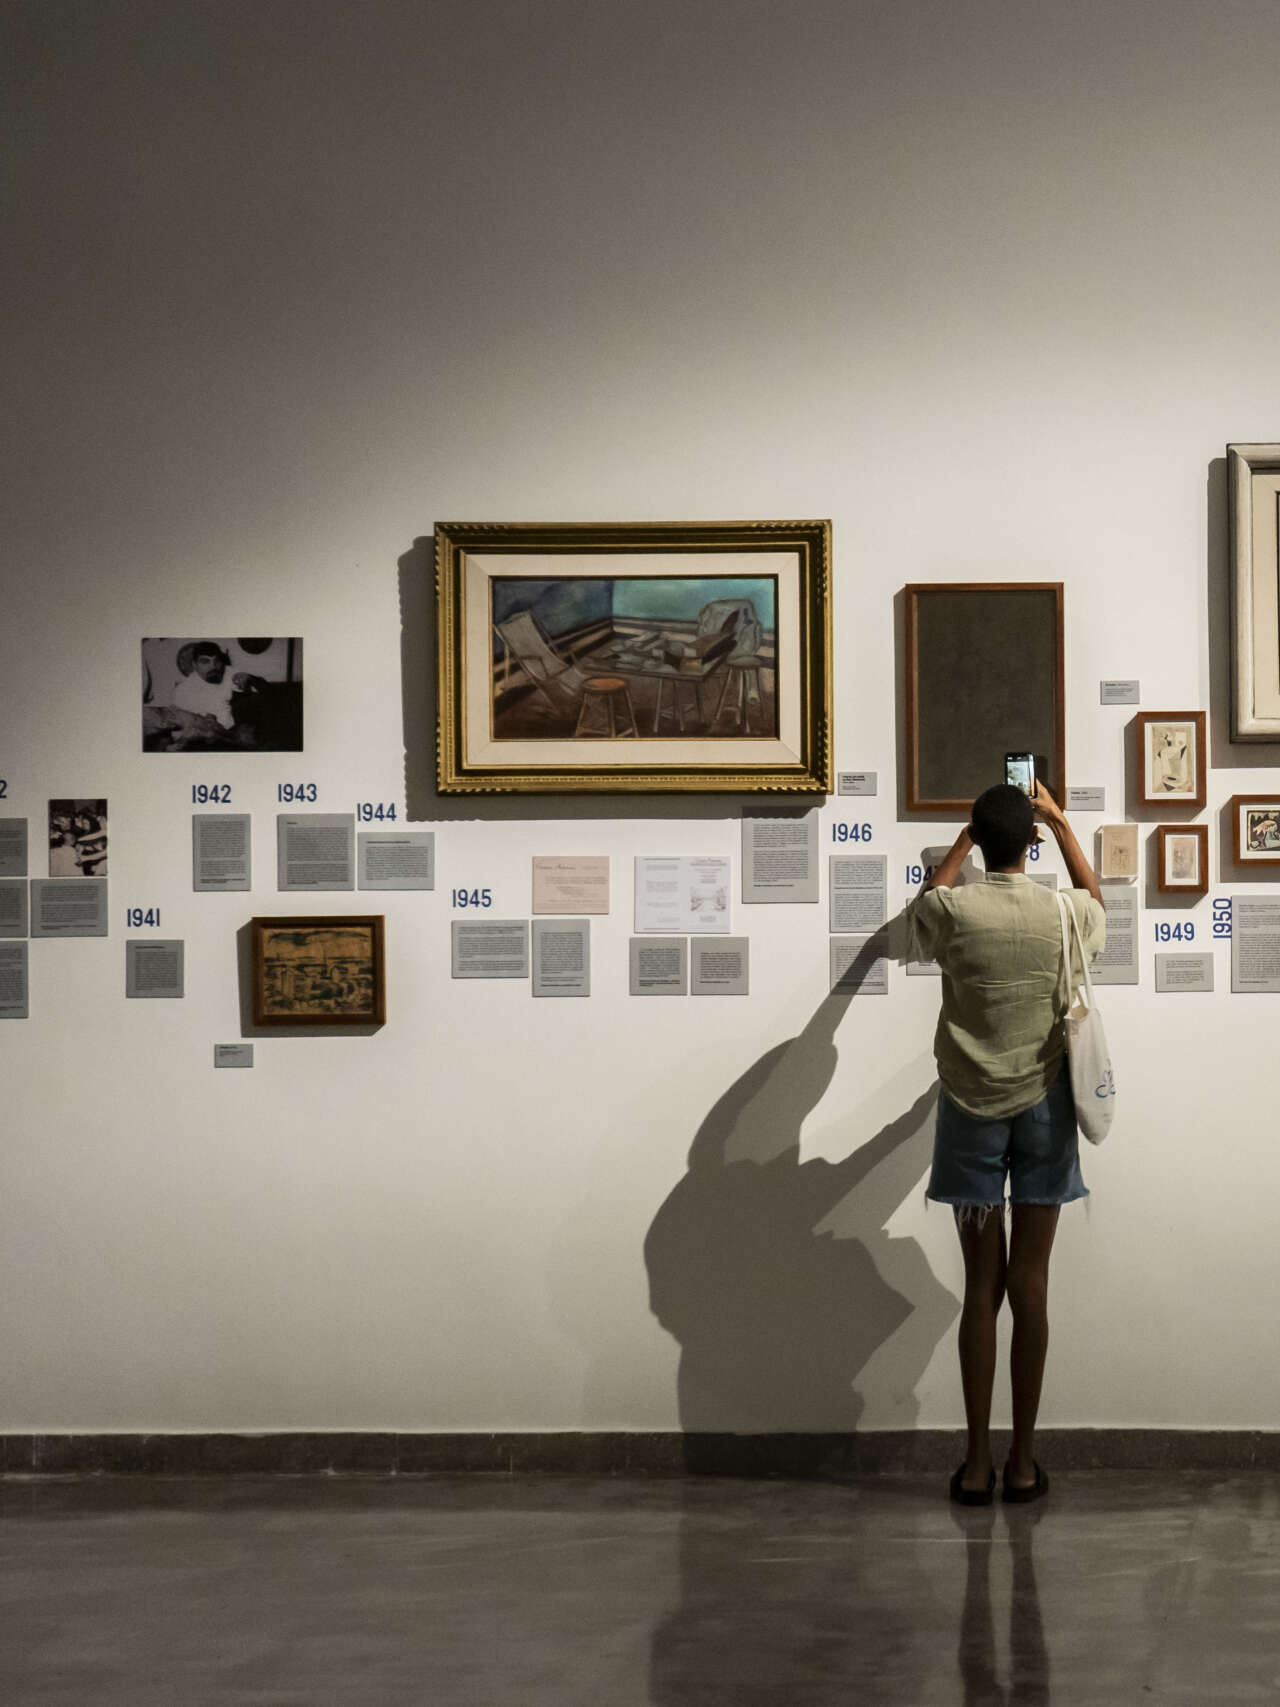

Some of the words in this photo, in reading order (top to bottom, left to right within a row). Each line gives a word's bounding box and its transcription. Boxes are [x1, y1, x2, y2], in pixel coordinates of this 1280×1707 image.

[193, 785, 231, 803] 1942
[278, 784, 317, 802] 1943
[357, 803, 396, 821] 1944
[832, 824, 871, 842] 1946
[906, 865, 937, 884] 194
[452, 889, 491, 907] 1945
[127, 909, 160, 927] 1941
[1213, 898, 1232, 939] 1950
[1155, 922, 1194, 941] 1949
